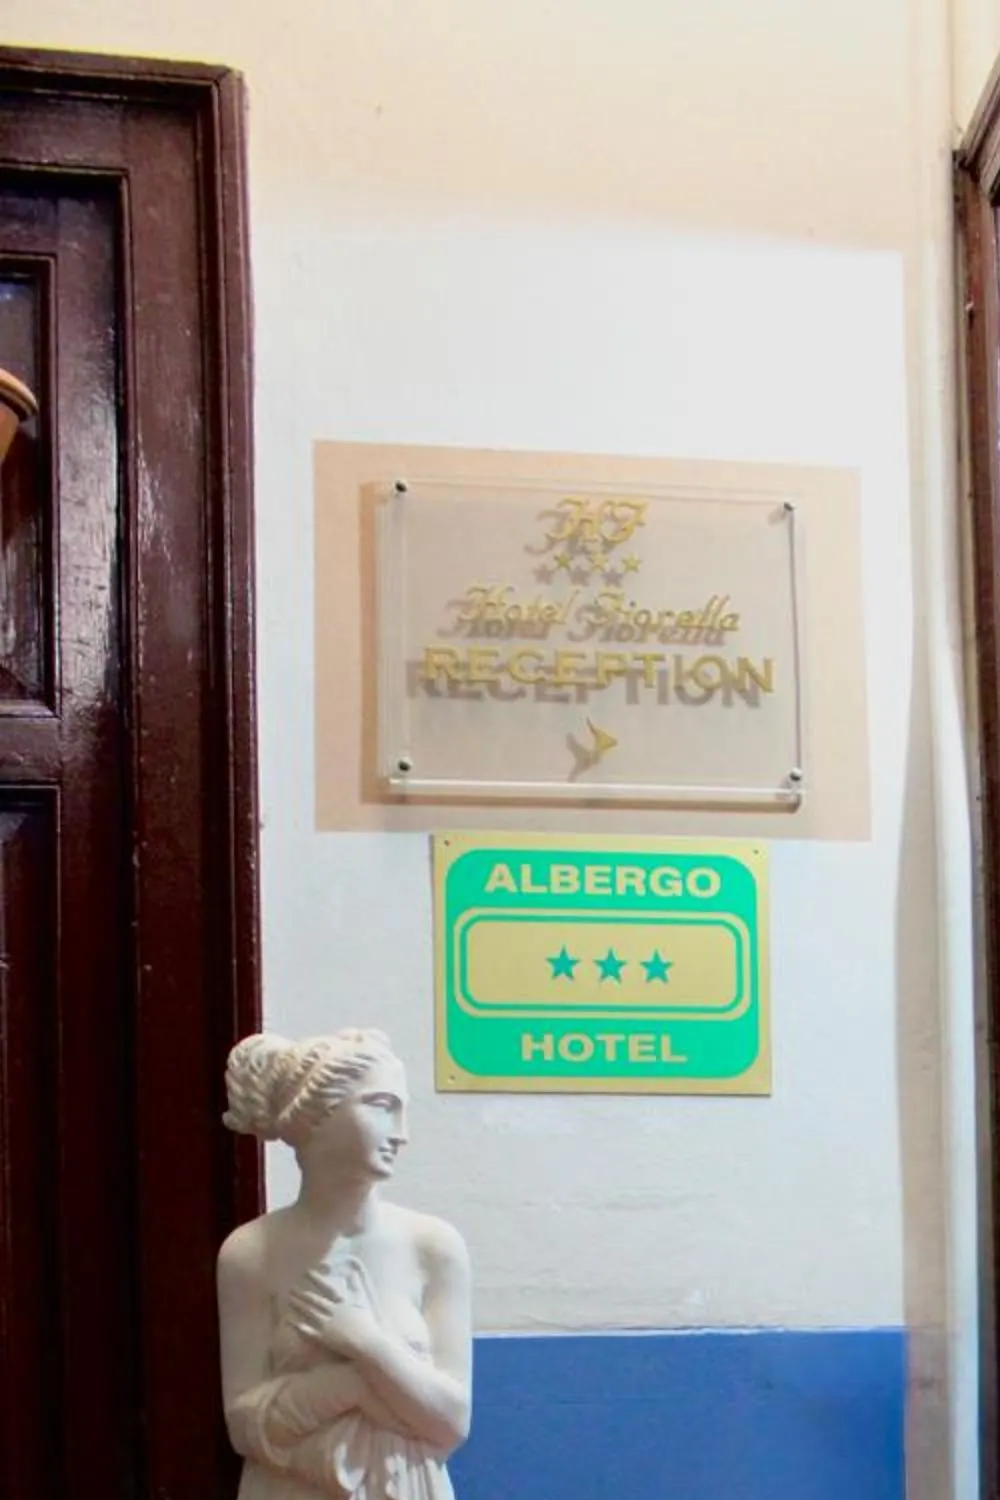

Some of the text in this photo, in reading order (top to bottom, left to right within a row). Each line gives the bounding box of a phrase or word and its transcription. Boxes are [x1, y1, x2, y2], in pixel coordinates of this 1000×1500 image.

[456, 584, 741, 633] Hotel Fiorella
[421, 645, 774, 693] RECEPTION
[484, 862, 721, 898] ALBERGO
[520, 1032, 688, 1063] HOTEL
